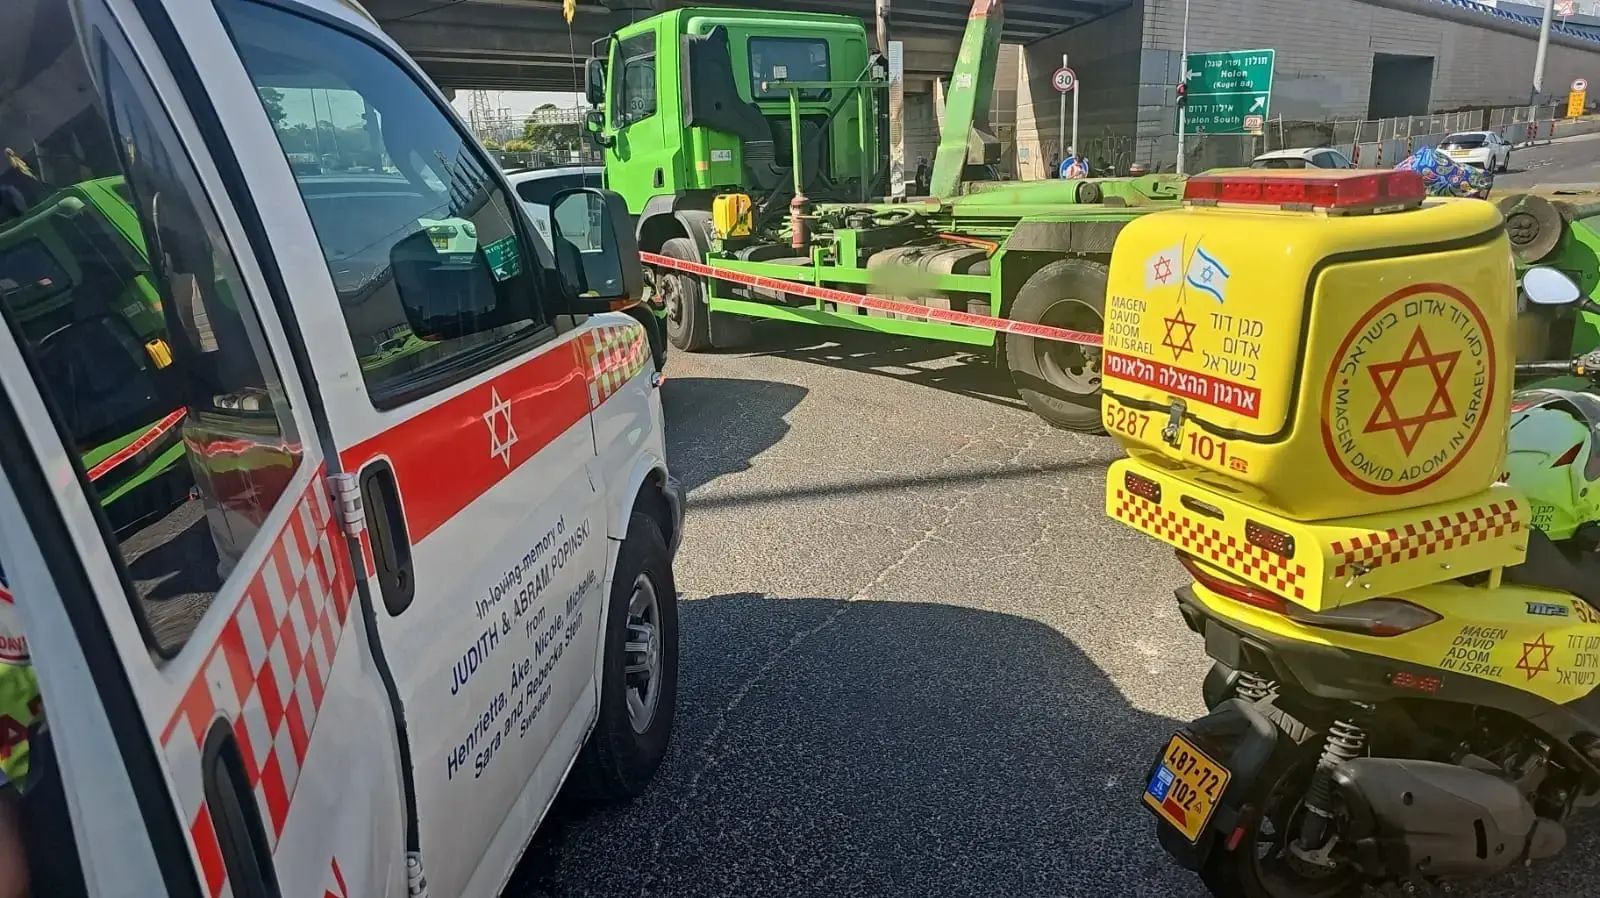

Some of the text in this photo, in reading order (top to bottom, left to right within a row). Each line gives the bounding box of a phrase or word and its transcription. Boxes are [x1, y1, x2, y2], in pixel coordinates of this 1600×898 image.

[1245, 56, 1268, 66] חולון
[1057, 75, 1072, 85] 30
[1220, 70, 1248, 78] Holon
[1188, 103, 1234, 113] אילון דרום
[1213, 116, 1240, 124] South
[1111, 296, 1147, 313] MAGEN
[1110, 309, 1140, 325] DAVID
[1210, 312, 1264, 338] מגן דוד
[1109, 324, 1140, 338] ADOM
[1340, 299, 1482, 377] מגן דוד אדום בישראל
[1108, 336, 1154, 355] IN ISRAEL
[1223, 336, 1261, 360] אדום
[1202, 350, 1257, 381] בישראל
[1107, 355, 1256, 411] ארגון ההצלה הלאומי
[1106, 405, 1150, 438] 5287
[1335, 365, 1485, 482] MAGEN DAVID ADOM IN ISRAEL
[1188, 431, 1227, 466] 101
[557, 514, 566, 535] of
[451, 518, 590, 696] JUDITH & ABRAM POPINSKI
[526, 606, 546, 639] from
[1459, 624, 1508, 640] MAGEN
[1452, 636, 1495, 650] DAVID
[1567, 634, 1583, 648] דוד
[1446, 647, 1490, 663] ADOM
[1575, 653, 1599, 668] אדום
[1439, 657, 1504, 677] IN ISRAEL
[1556, 667, 1596, 686] בישראל
[447, 692, 508, 780] Henrietta,
[535, 614, 564, 661] Nicole,
[475, 612, 583, 779] Sara and Rebecka Stein
[520, 684, 551, 738] Sweden
[1171, 778, 1197, 811] 102
